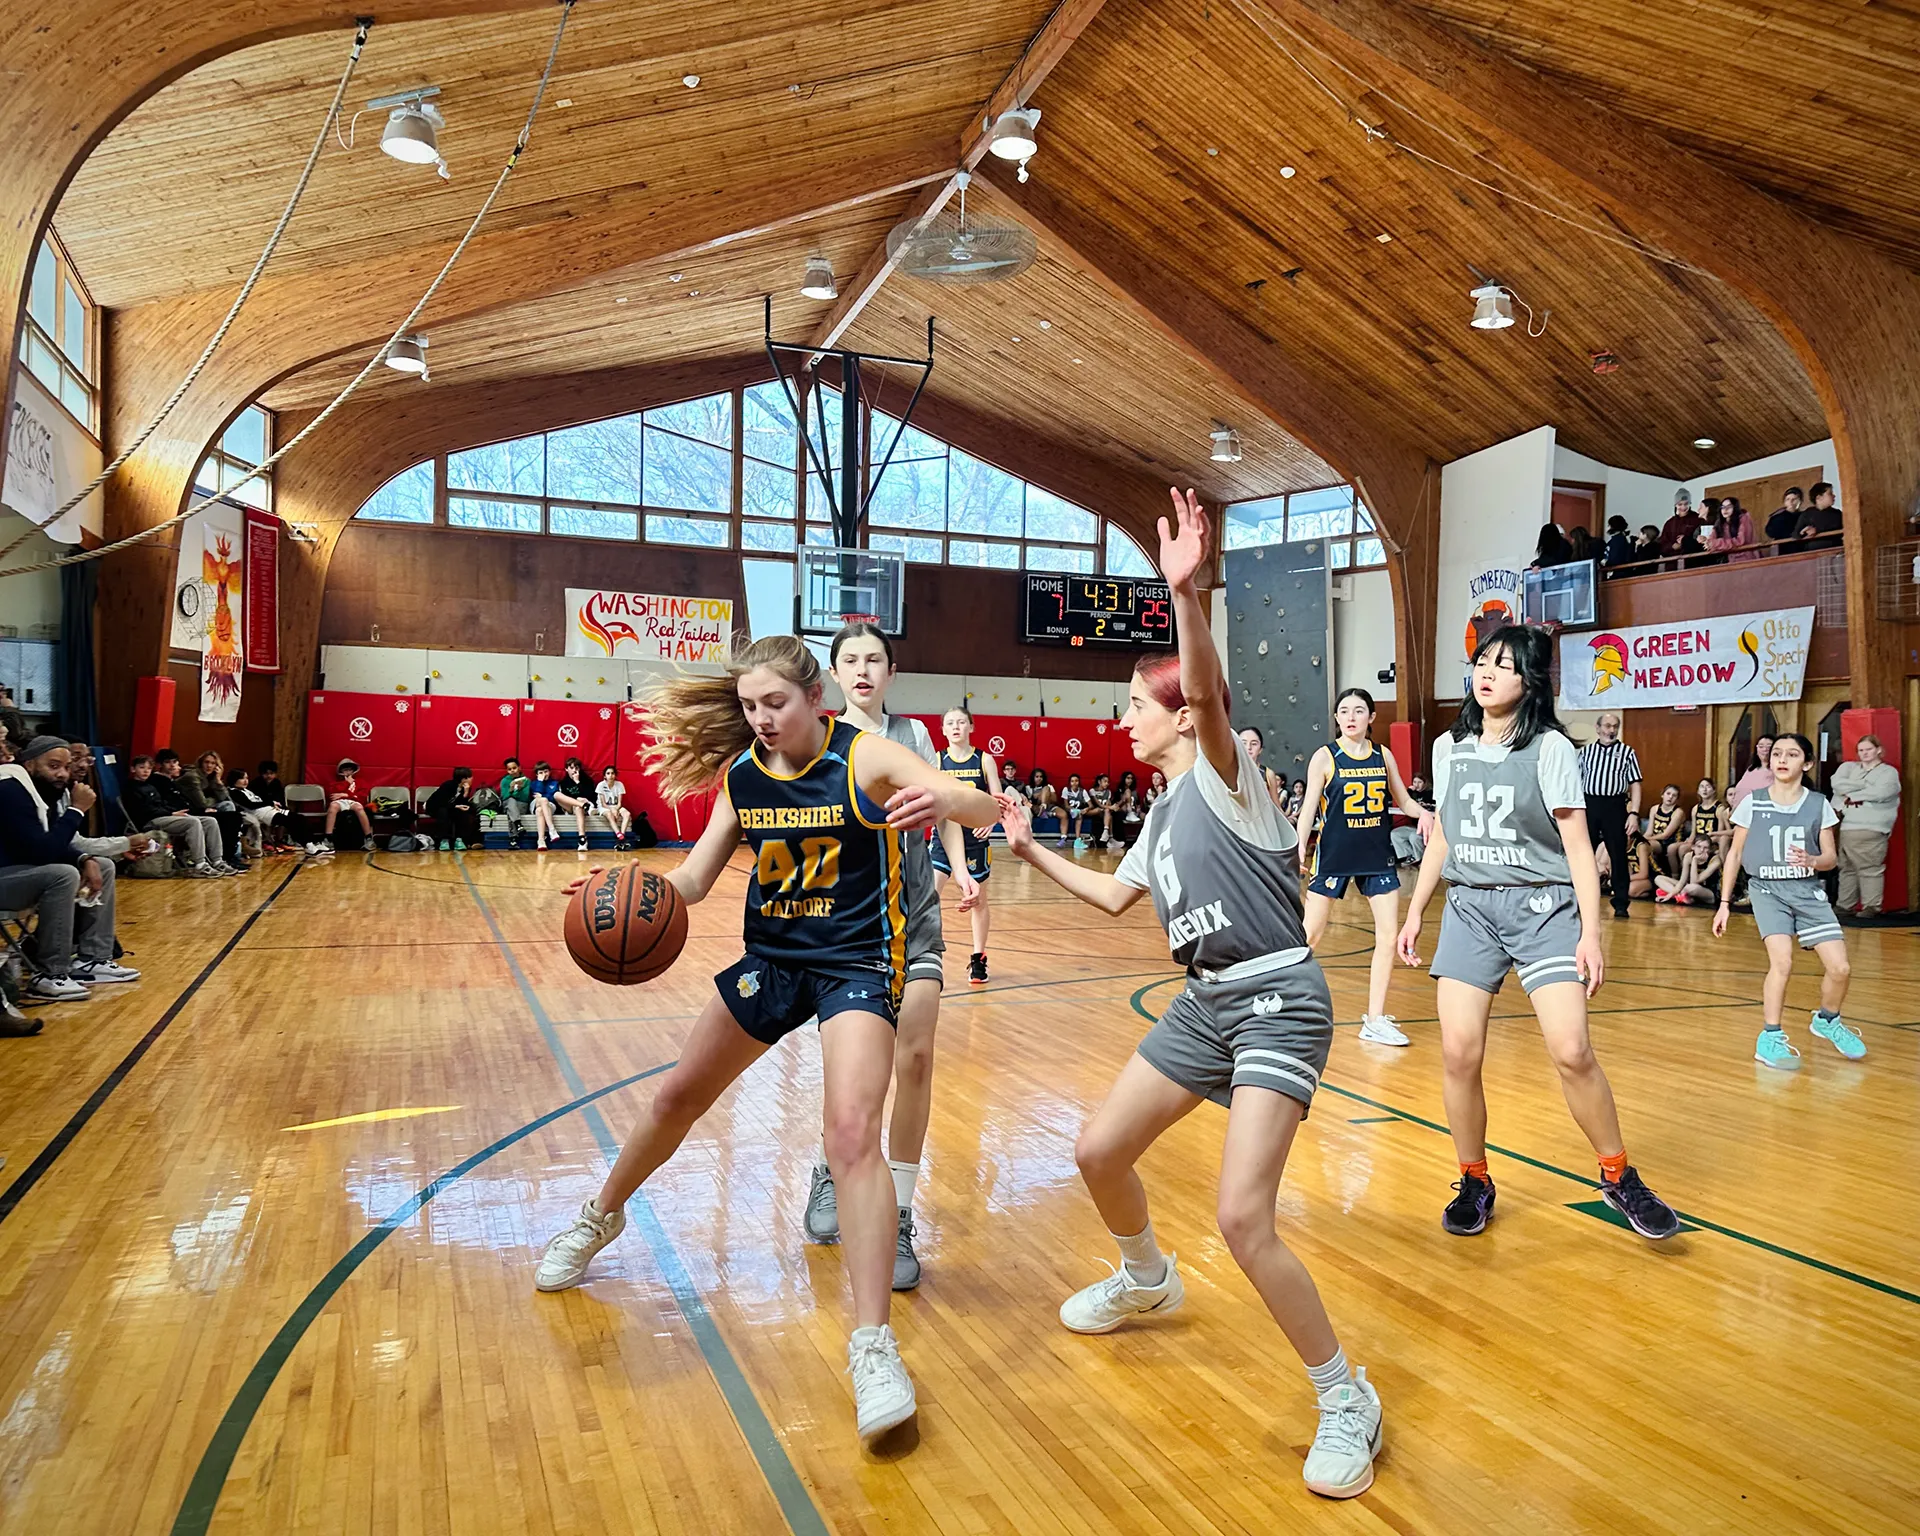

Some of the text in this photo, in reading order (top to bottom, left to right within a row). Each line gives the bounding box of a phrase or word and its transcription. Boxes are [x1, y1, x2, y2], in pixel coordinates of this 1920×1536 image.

[1031, 579, 1064, 592] HOME
[1136, 586, 1170, 600] GUEST
[1469, 569, 1520, 599] KIMBERTON
[599, 592, 731, 621] WASHINGTON
[1051, 593, 1064, 620] 7
[1084, 583, 1132, 612] 4:31
[1090, 611, 1112, 619] PERIOD
[1141, 600, 1169, 628] 25
[1046, 626, 1070, 634] BONUS
[1095, 619, 1106, 636] 2
[1130, 630, 1153, 639] BONUS
[1763, 619, 1800, 640] Otto
[1070, 636, 1084, 646] 88
[1633, 629, 1710, 658] GREEN
[1633, 661, 1736, 689] MEADOW
[1343, 780, 1386, 814] 25
[738, 804, 845, 829] BERKSHIRE
[1347, 817, 1381, 828] WALDORF
[1459, 782, 1517, 841] 32
[1696, 819, 1714, 833] 24
[1454, 843, 1532, 866] PHOENIX
[1769, 825, 1805, 863] 16
[757, 836, 842, 893] 40
[1154, 825, 1182, 910] 6
[1759, 865, 1815, 879] PHOENIX
[594, 866, 623, 934] Wilson
[760, 898, 835, 919] WALDORF
[1168, 899, 1233, 952] OENIX
